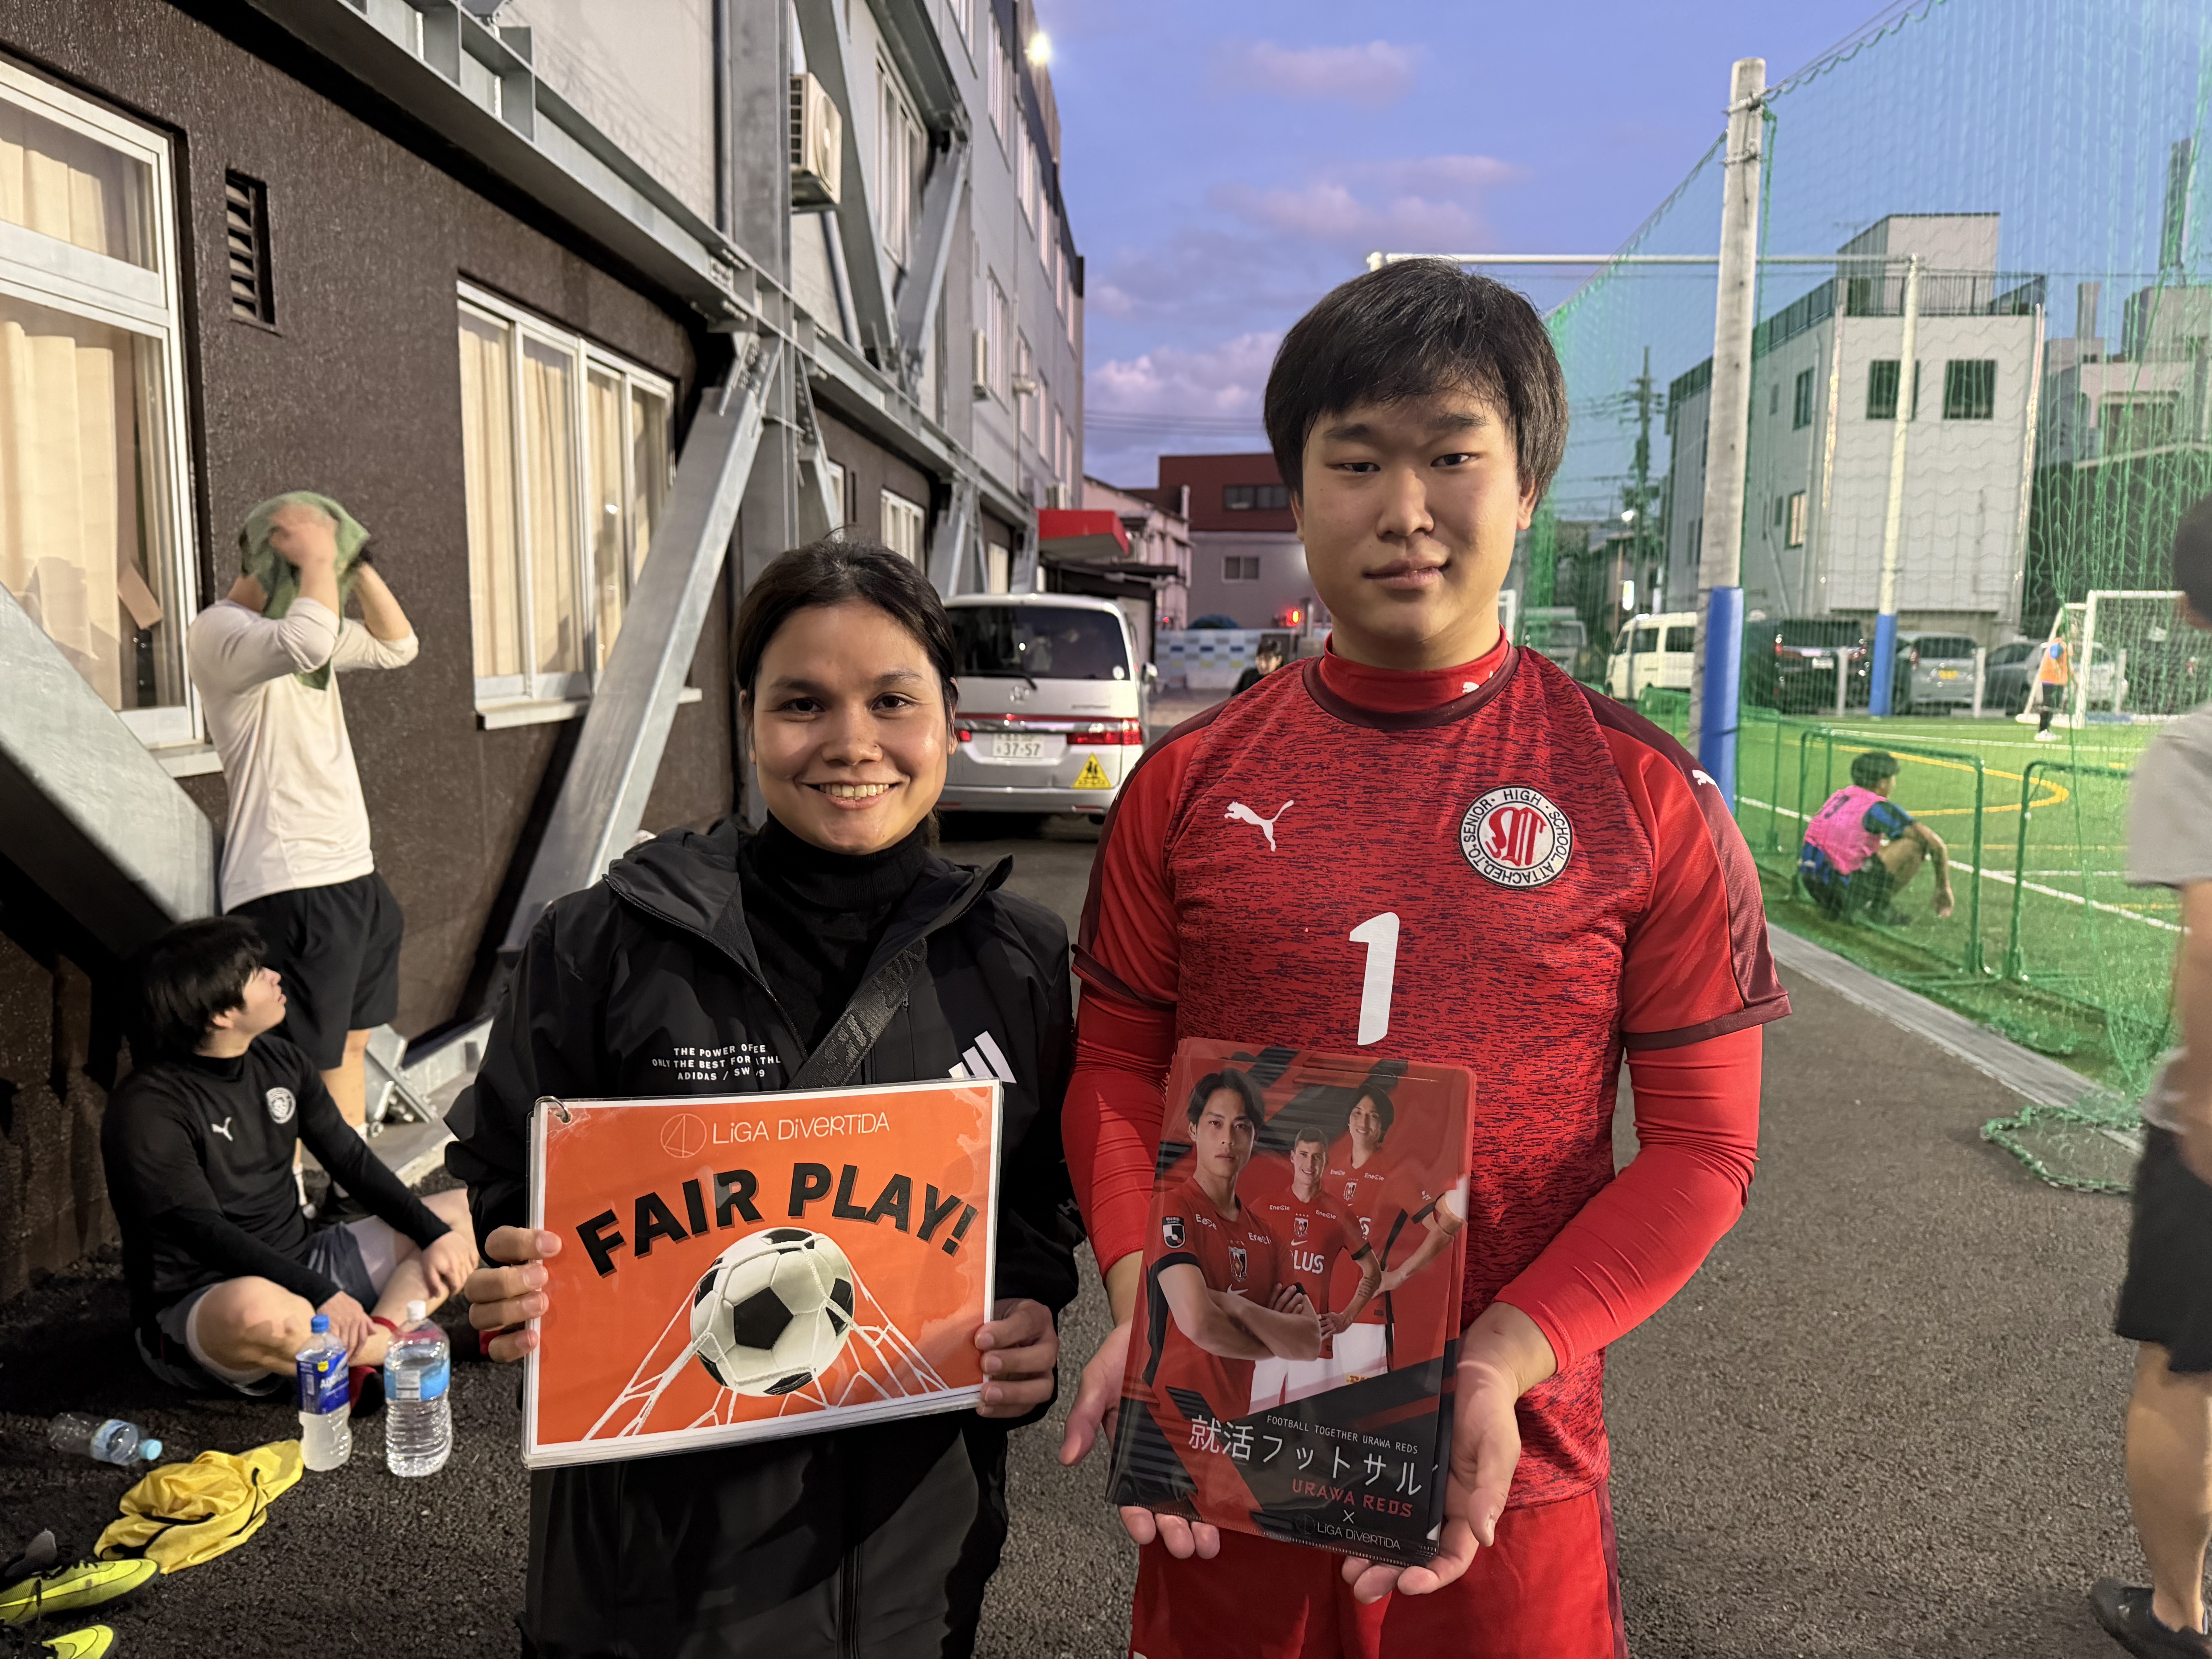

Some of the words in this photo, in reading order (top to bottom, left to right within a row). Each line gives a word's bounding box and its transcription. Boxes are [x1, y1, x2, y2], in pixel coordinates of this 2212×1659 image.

[1503, 789, 1542, 805] HIGH
[1463, 799, 1492, 842] SENIOR
[1549, 811, 1569, 861] SCHOOL
[1468, 848, 1481, 867] TO
[1484, 861, 1554, 884] ATTACHED
[1349, 912, 1400, 1046] 1
[652, 1059, 670, 1068] ONLY
[673, 1060, 694, 1068] THE
[699, 1060, 725, 1069] BEST
[730, 1055, 751, 1065] FOR
[674, 1048, 696, 1056] THE
[699, 1045, 736, 1058] POWER
[677, 1072, 717, 1081] ADIDAS
[575, 1169, 765, 1279] FAIR
[787, 1162, 979, 1257] PLAY!
[1188, 1414, 1422, 1496] 就活フットサル
[1267, 1415, 1309, 1432] FOOTBALL
[1314, 1424, 1358, 1443] TOGETHER
[1362, 1435, 1391, 1449] URAWA
[1395, 1441, 1418, 1455] REDS
[1292, 1478, 1355, 1506] URAWA
[1362, 1494, 1413, 1518] REDS
